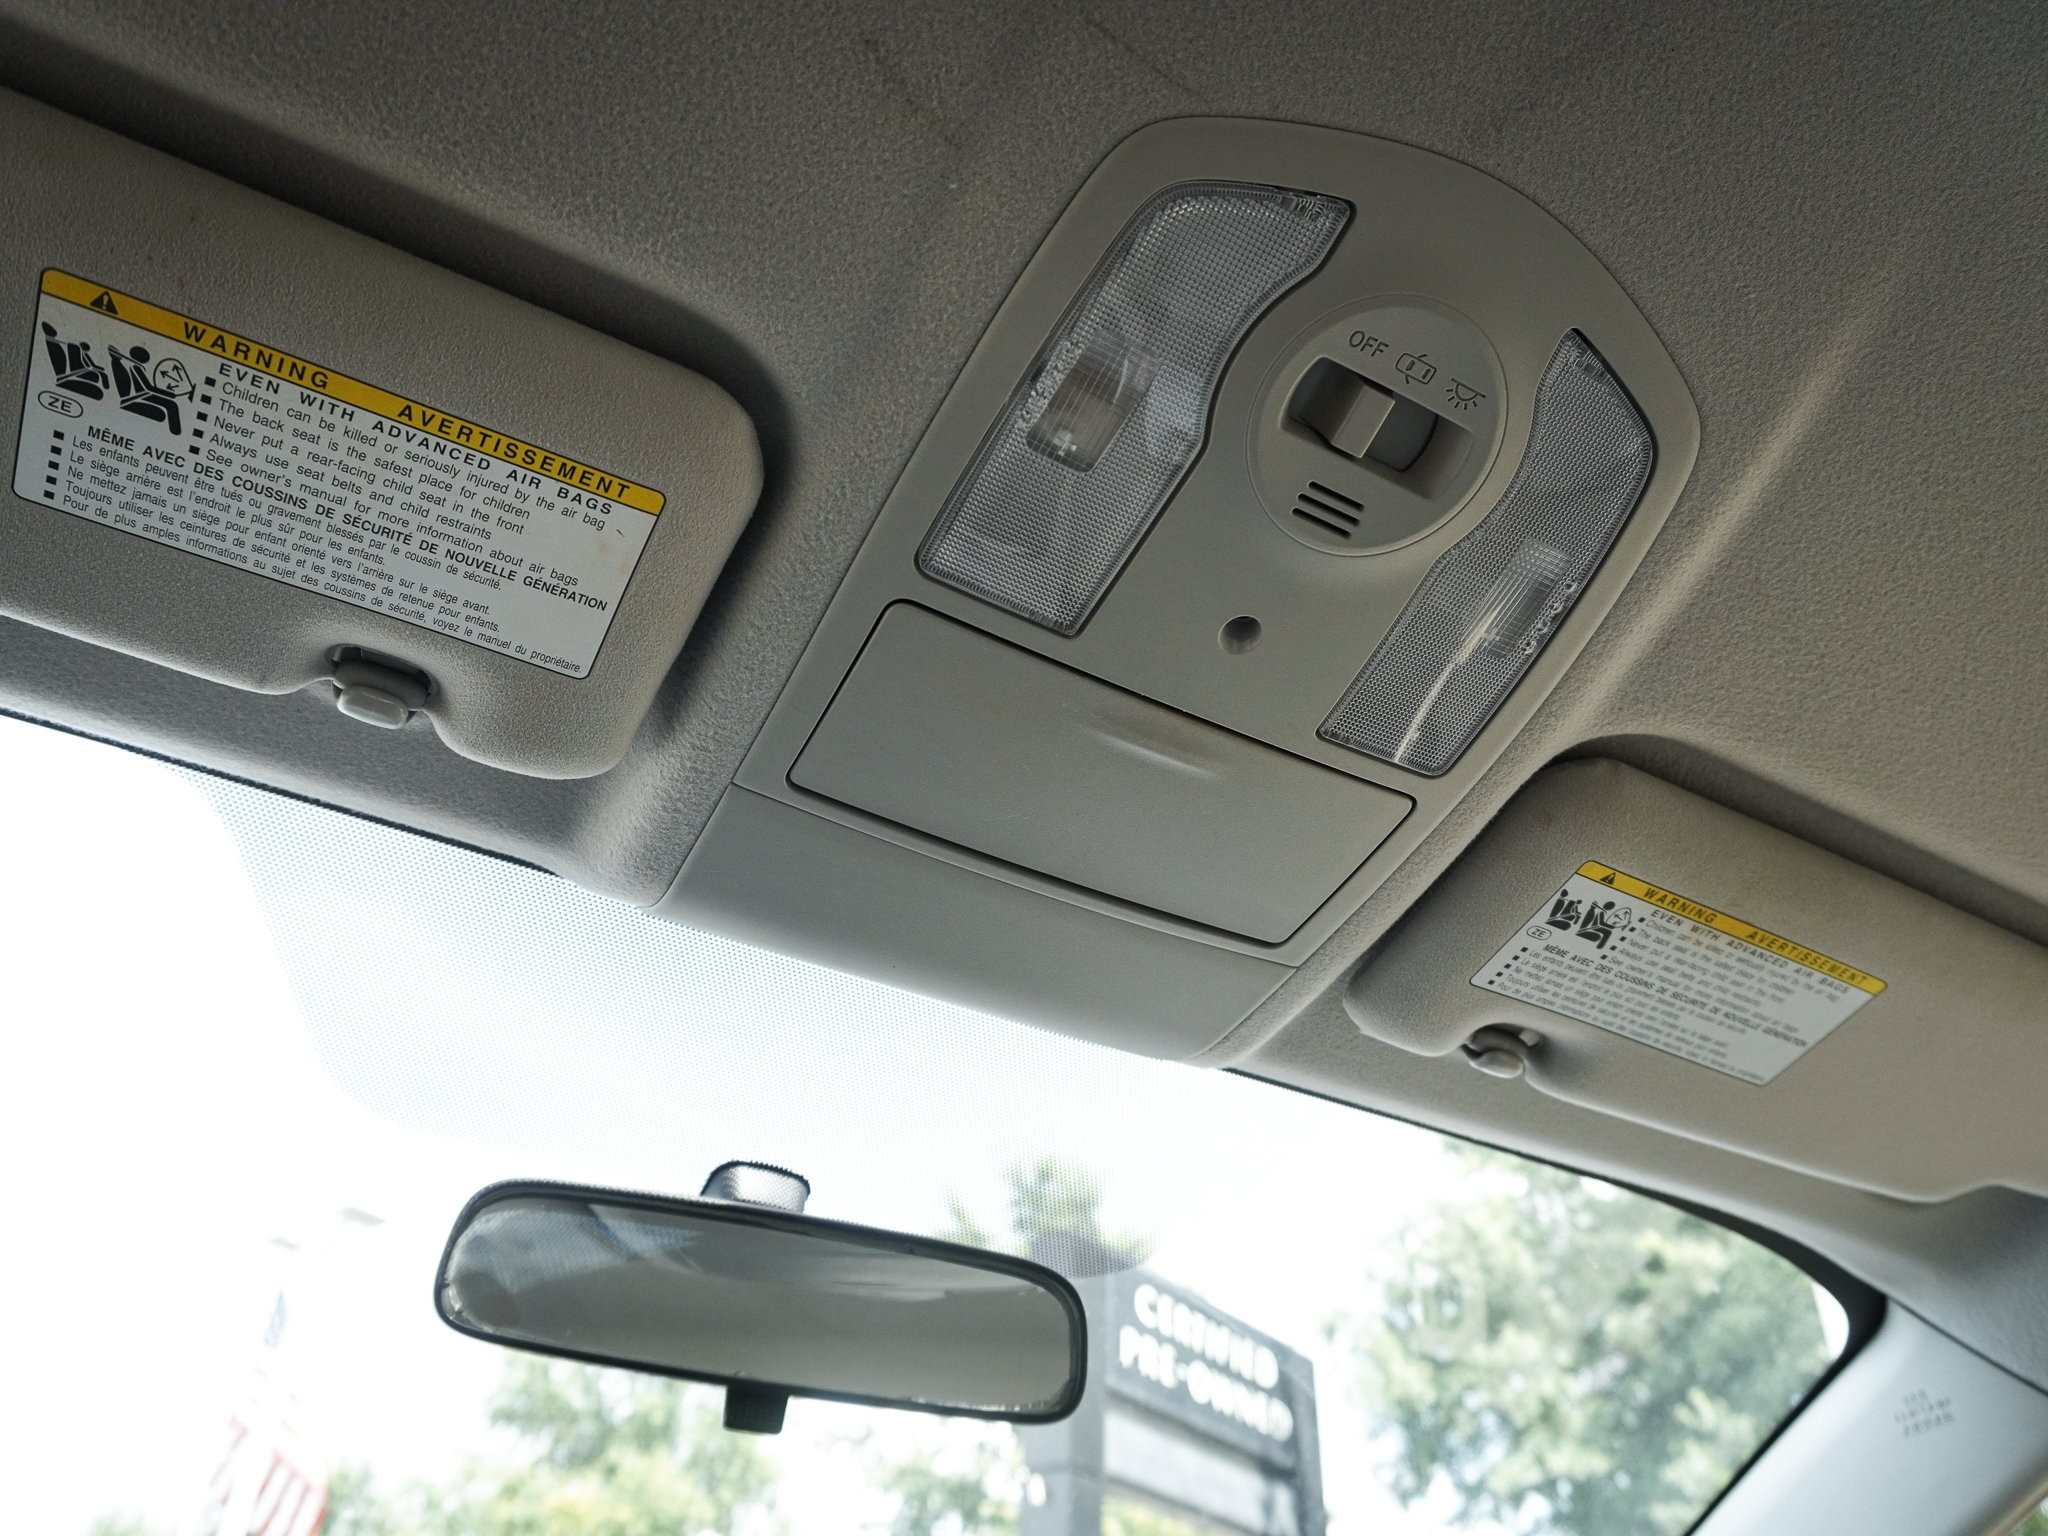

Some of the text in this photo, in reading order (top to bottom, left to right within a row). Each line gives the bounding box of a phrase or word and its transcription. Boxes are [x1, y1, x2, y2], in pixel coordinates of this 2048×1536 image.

[47, 395, 73, 414] ZE
[1348, 330, 1389, 358] OFF
[183, 321, 631, 499] WARNING AVERTISSEMENT
[218, 361, 613, 515] EVEN WITH ADVANCED AIR BAGS
[218, 397, 531, 520] The back seat is the safest place for children
[222, 381, 606, 532] Children can be killed or seriously injured by the air bag
[69, 449, 85, 465] Le
[90, 458, 120, 478] siège
[125, 471, 161, 491] arrière
[166, 485, 184, 499] est
[235, 506, 246, 519] le
[249, 513, 273, 528] plus
[277, 522, 296, 535] sûr
[298, 530, 324, 545] pour
[327, 536, 343, 552] les
[347, 546, 385, 566] enfants.
[72, 435, 501, 591] Les enfants peuvent être tués ou gravement blessés par le coussin de sécurité.
[87, 424, 608, 612] MÊME AVEC DES COUSSINS DE SÉCURITÉ DE NOUVELLE GÉNÉRATION
[205, 448, 233, 468] See
[299, 483, 348, 507] manual
[353, 499, 372, 515] for
[377, 510, 410, 529] more
[415, 521, 484, 554] information
[488, 549, 524, 568] about
[528, 562, 546, 575] air
[549, 567, 579, 587] bags
[209, 432, 492, 541] Always use seat belts and child restraints
[213, 415, 525, 535] Never put a rear-facing child seat in the front
[62, 494, 584, 675] Pour de plus amples informations au sujet des coussins de sécurité, voyez le manuel du propriétaire.
[65, 479, 500, 633] Toujours utiliser les ceintures de sécurité et les systèmes de retenue pour enfants.
[67, 464, 84, 481] Ne
[89, 475, 127, 496] mettez
[130, 486, 167, 509] jamais
[172, 503, 187, 515] un
[191, 508, 221, 526] siège
[224, 520, 251, 535] pour
[254, 530, 287, 548] enfant
[291, 542, 327, 561] orienté
[331, 555, 353, 569] vers
[398, 578, 416, 590] sur
[418, 582, 428, 594] le
[432, 588, 459, 605] siège
[462, 599, 490, 616] avant.
[1531, 927, 1547, 938] ZE
[1542, 943, 1571, 959] MÊME
[1568, 954, 1595, 968] AVEC
[1593, 962, 1614, 975] DES
[1636, 928, 1653, 940] The
[1643, 887, 1718, 924] WARNING
[1745, 930, 1868, 982] AVERTISSEMENT
[1650, 908, 1685, 927] EVEN
[1689, 923, 1722, 942] WITH
[1724, 939, 1789, 969] ADVANCED
